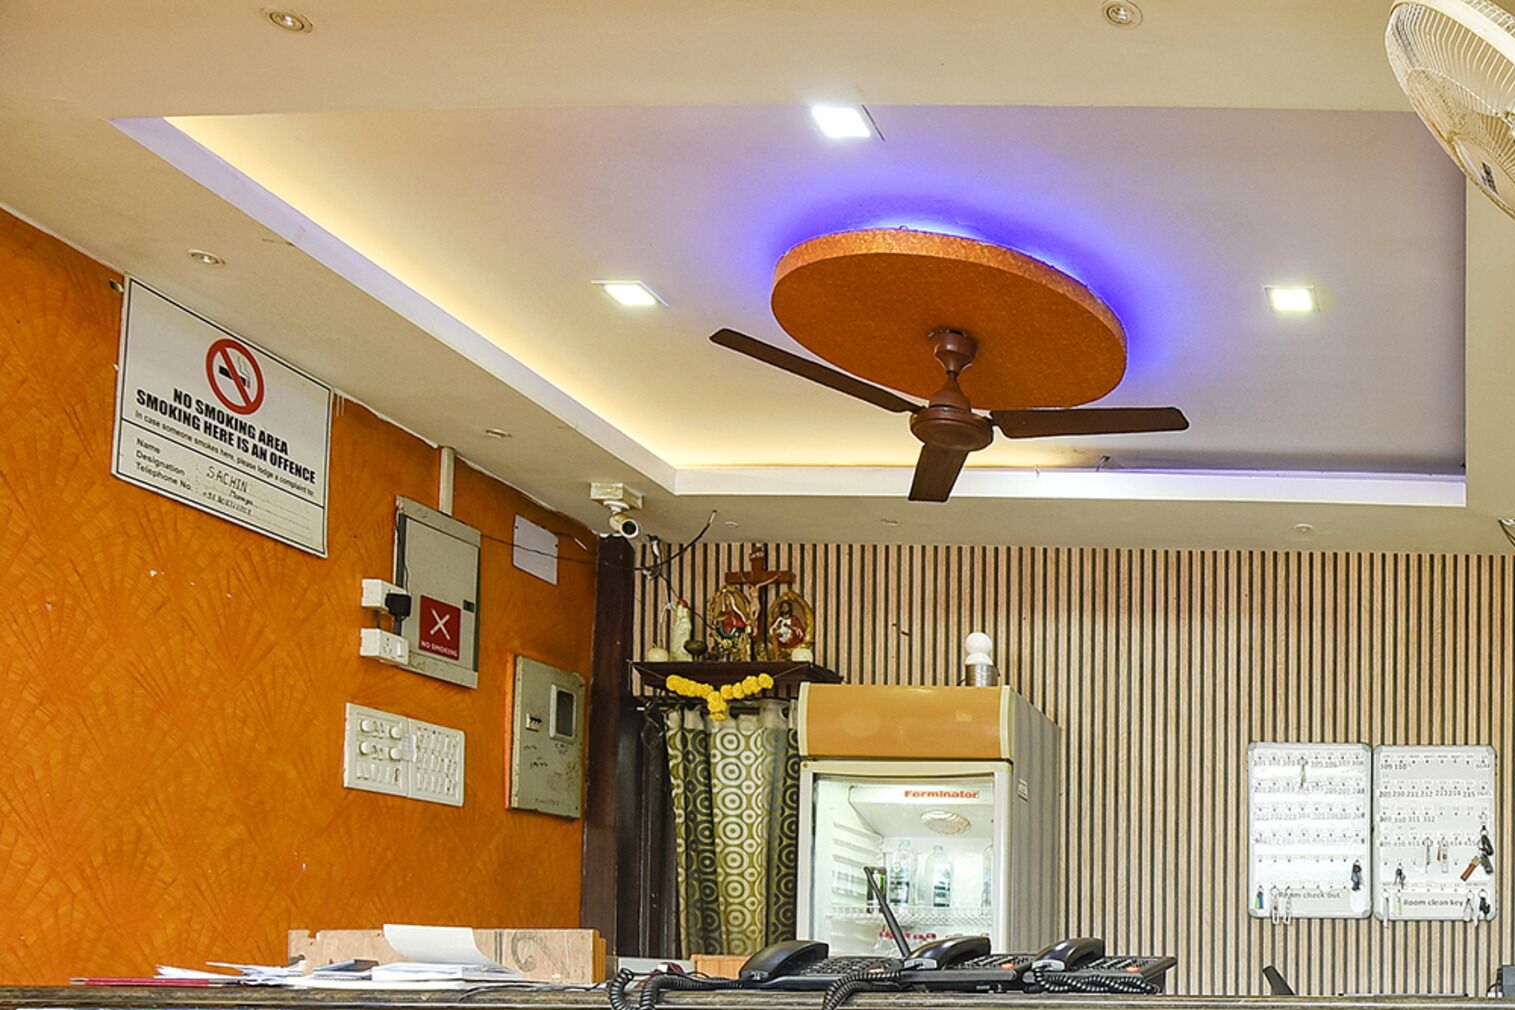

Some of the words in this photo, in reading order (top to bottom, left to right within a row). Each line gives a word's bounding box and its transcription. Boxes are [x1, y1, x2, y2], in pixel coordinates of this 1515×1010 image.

[173, 388, 192, 409] NO
[195, 399, 256, 440] SMOKING
[258, 430, 288, 456] AREA
[136, 389, 200, 431] SMOKING
[203, 420, 234, 447] HERE
[237, 436, 249, 453] IS
[251, 443, 267, 461] AN
[270, 452, 316, 485] OFFENCE
[136, 438, 160, 454] Name
[136, 450, 185, 475] Designation
[144, 415, 160, 428] case
[162, 423, 193, 442] someone
[194, 438, 219, 453] smokes
[237, 457, 256, 471] please
[280, 477, 306, 492] complaint
[136, 462, 178, 485] Telephone
[206, 465, 248, 493] SACHIN
[420, 640, 431, 649] NO
[431, 643, 458, 658] SMOKING
[1303, 890, 1325, 898] check
[1428, 898, 1449, 906] clean
[1450, 898, 1464, 908] key
